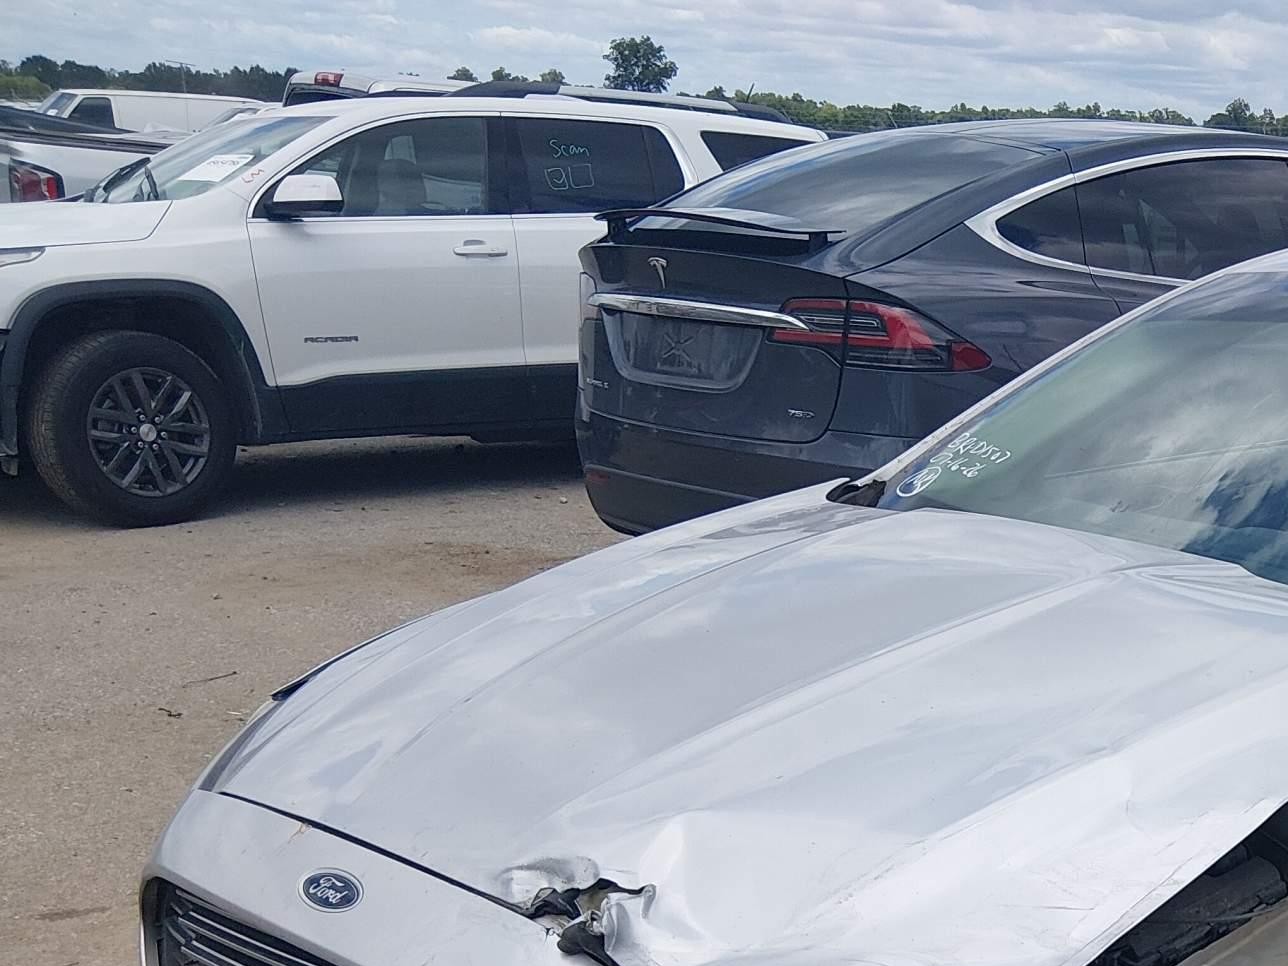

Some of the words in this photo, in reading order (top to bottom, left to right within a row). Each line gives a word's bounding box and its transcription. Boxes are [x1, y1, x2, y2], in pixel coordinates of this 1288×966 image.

[549, 139, 590, 158] Scan
[303, 335, 359, 344] ACADIA
[308, 876, 349, 904] Ford
